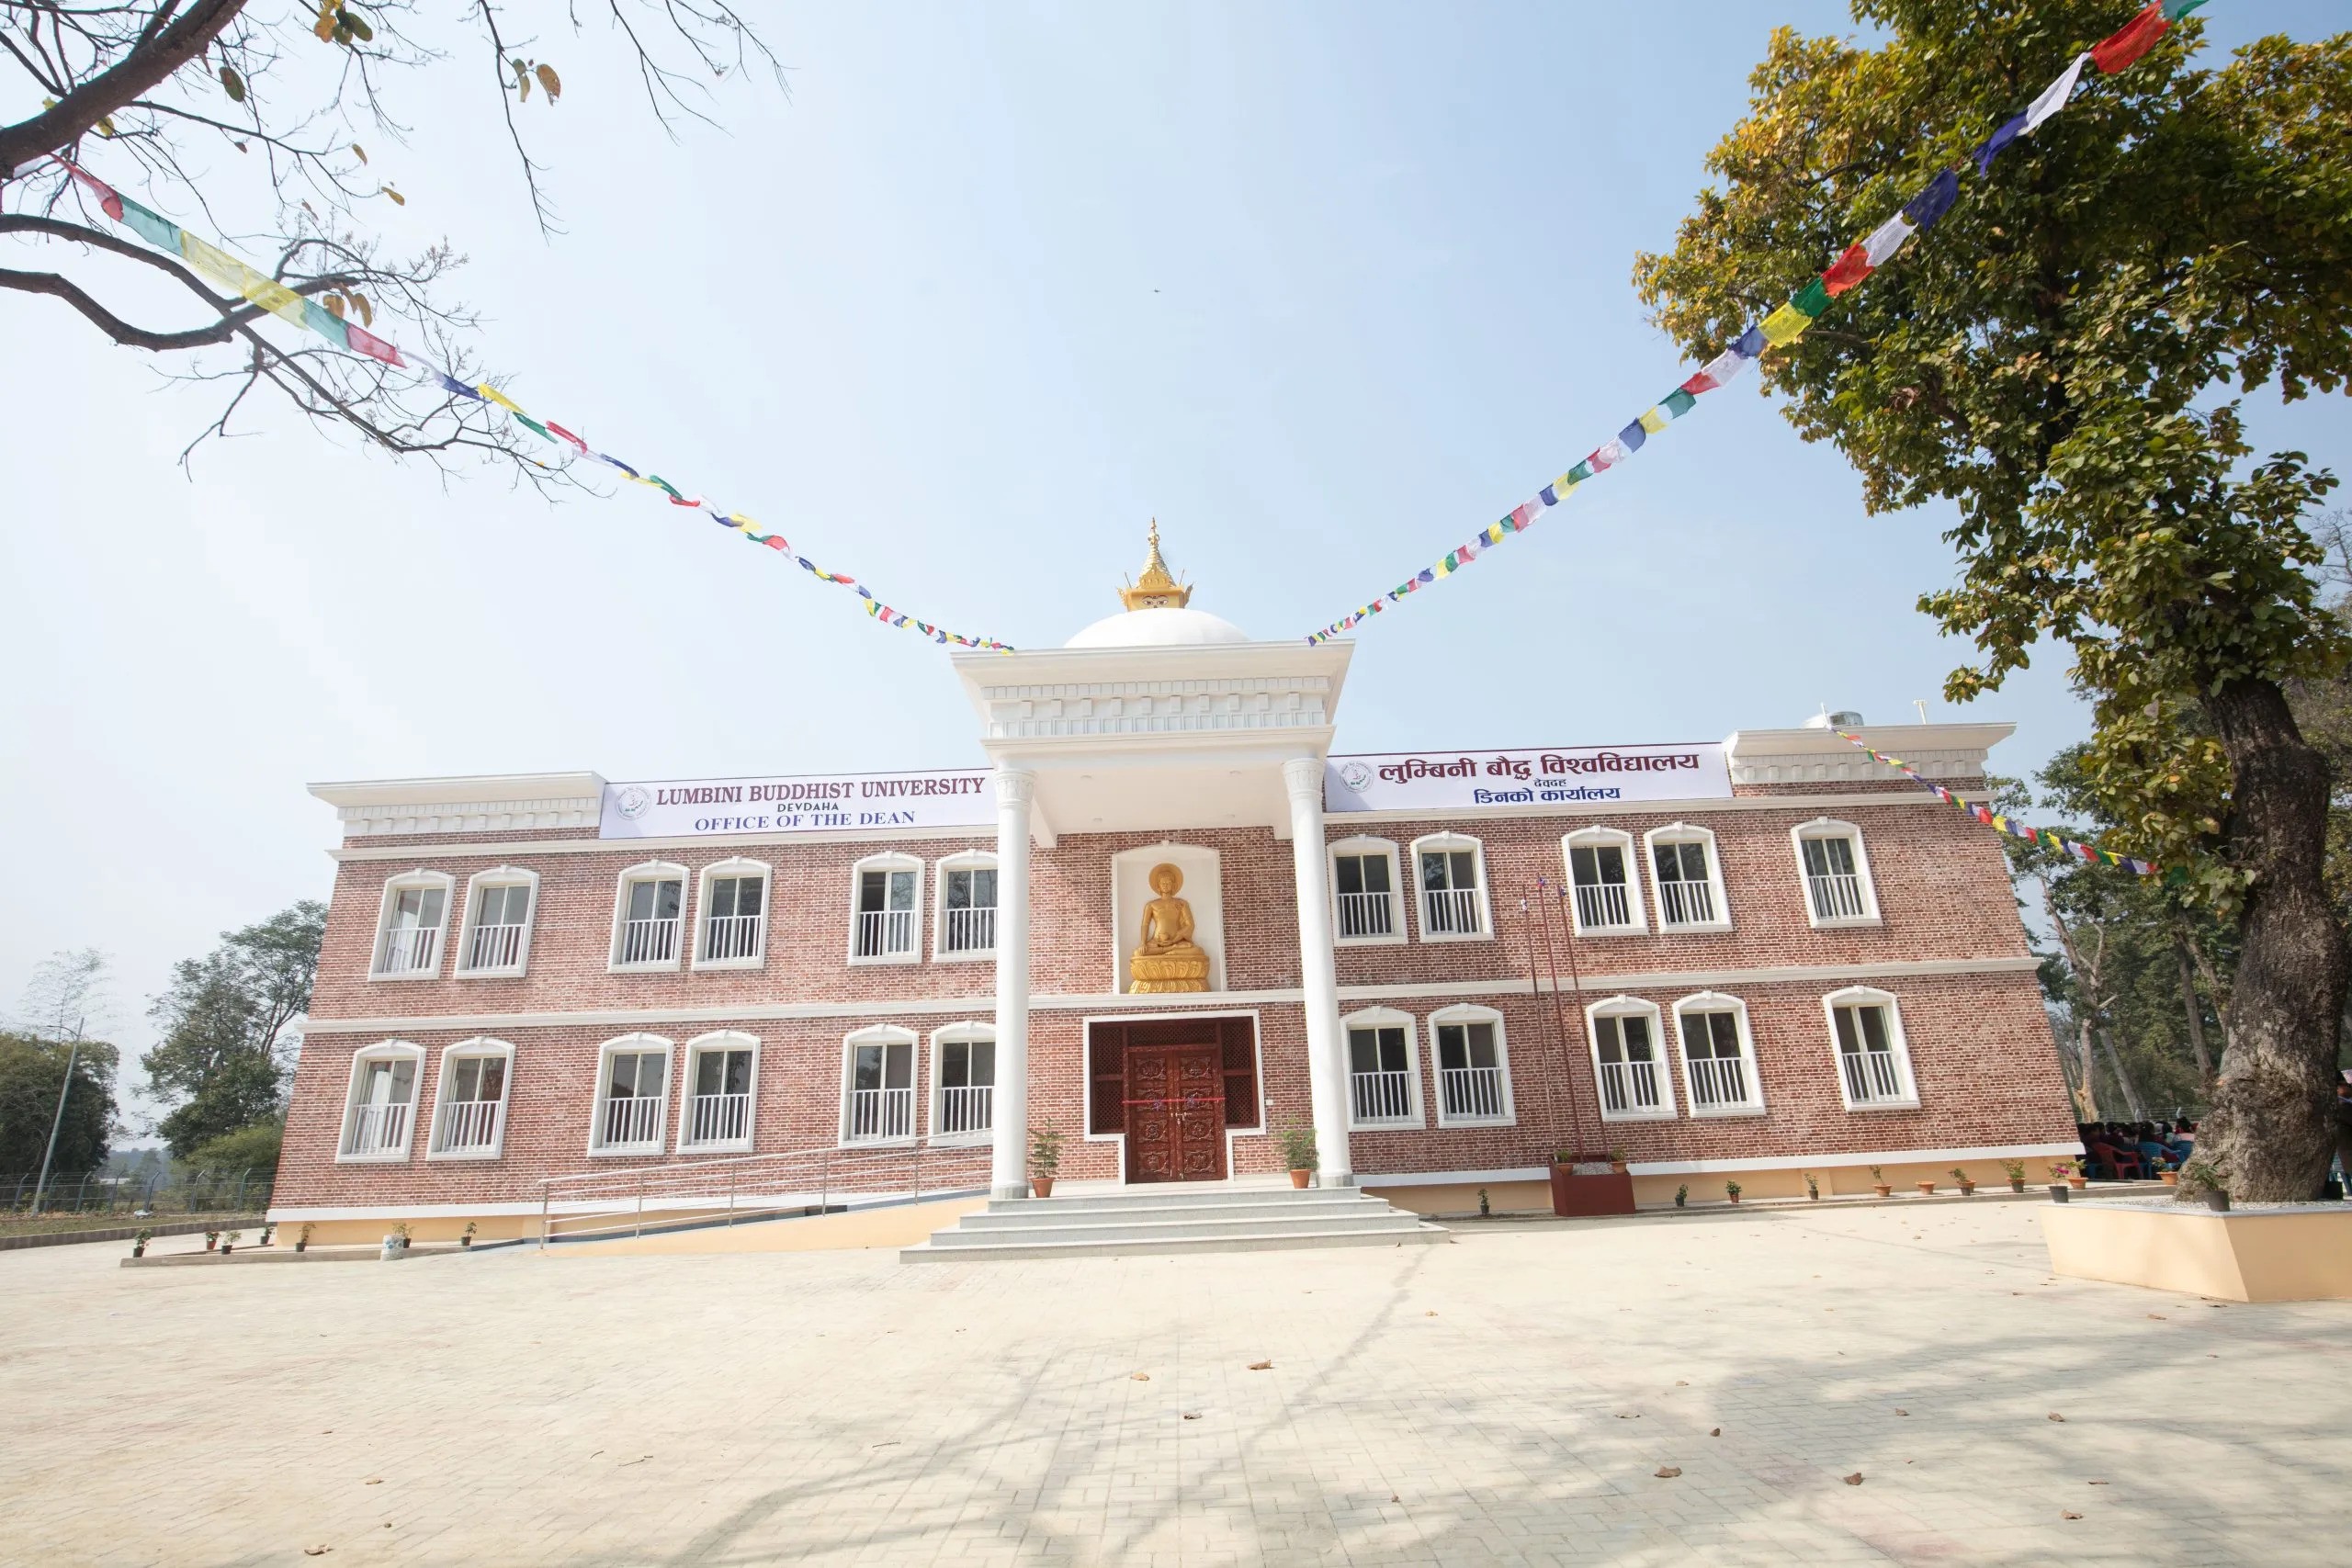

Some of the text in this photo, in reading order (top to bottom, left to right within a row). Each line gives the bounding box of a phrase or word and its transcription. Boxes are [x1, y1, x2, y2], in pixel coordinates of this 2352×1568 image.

[1378, 758, 1477, 784] लुम्बिनी
[1541, 752, 1699, 774] विश्वविद्यालय
[657, 785, 742, 806] LUMBINI
[750, 782, 854, 802] BUDDHIST
[862, 777, 985, 798] UNIVERSITY
[1474, 786, 1621, 804] डिनको कार्यालय
[777, 802, 839, 812] DEVDAHA
[695, 810, 916, 831] OFFICE OF THE DEAN
